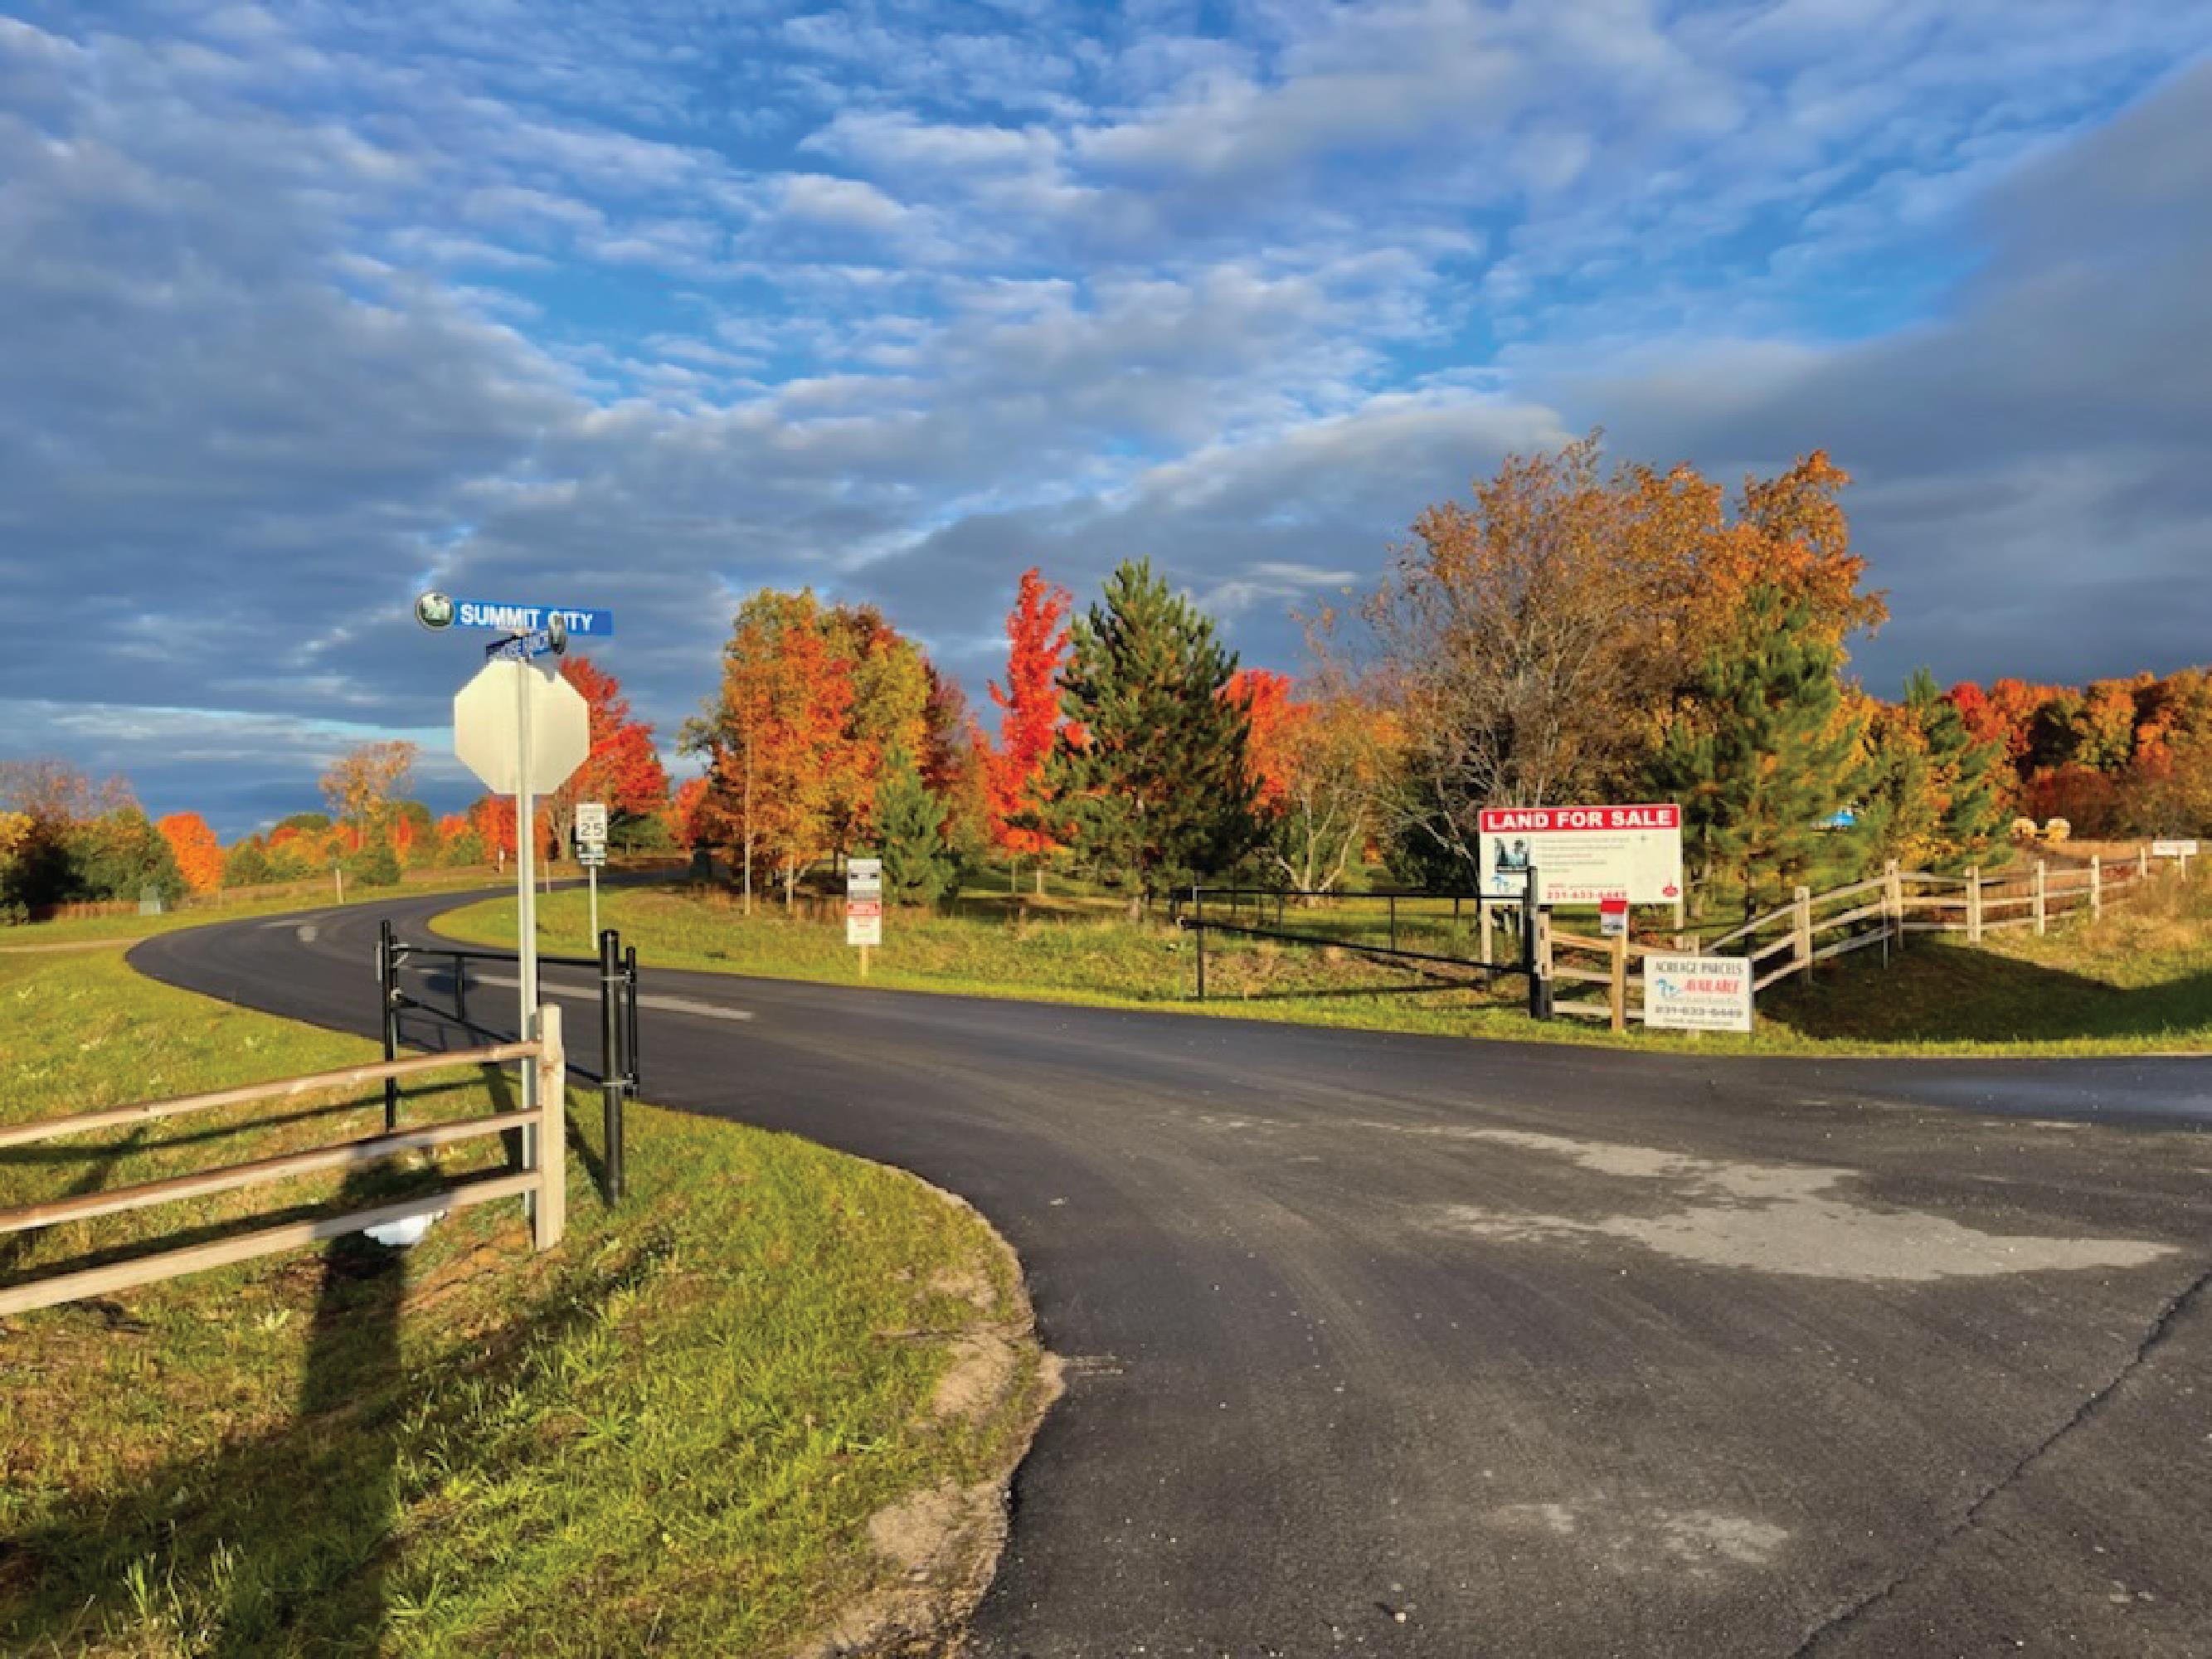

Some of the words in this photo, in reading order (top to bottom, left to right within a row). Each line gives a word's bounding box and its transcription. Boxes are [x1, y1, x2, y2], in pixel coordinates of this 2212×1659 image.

[459, 604, 540, 630] SUMMIT
[1487, 814, 1549, 830] LAND
[1556, 811, 1603, 828] FOR
[1610, 810, 1673, 827] SALE
[581, 822, 603, 836] 25
[1701, 961, 1743, 975] PARCELS
[1684, 978, 1739, 995] AVAILABLE
